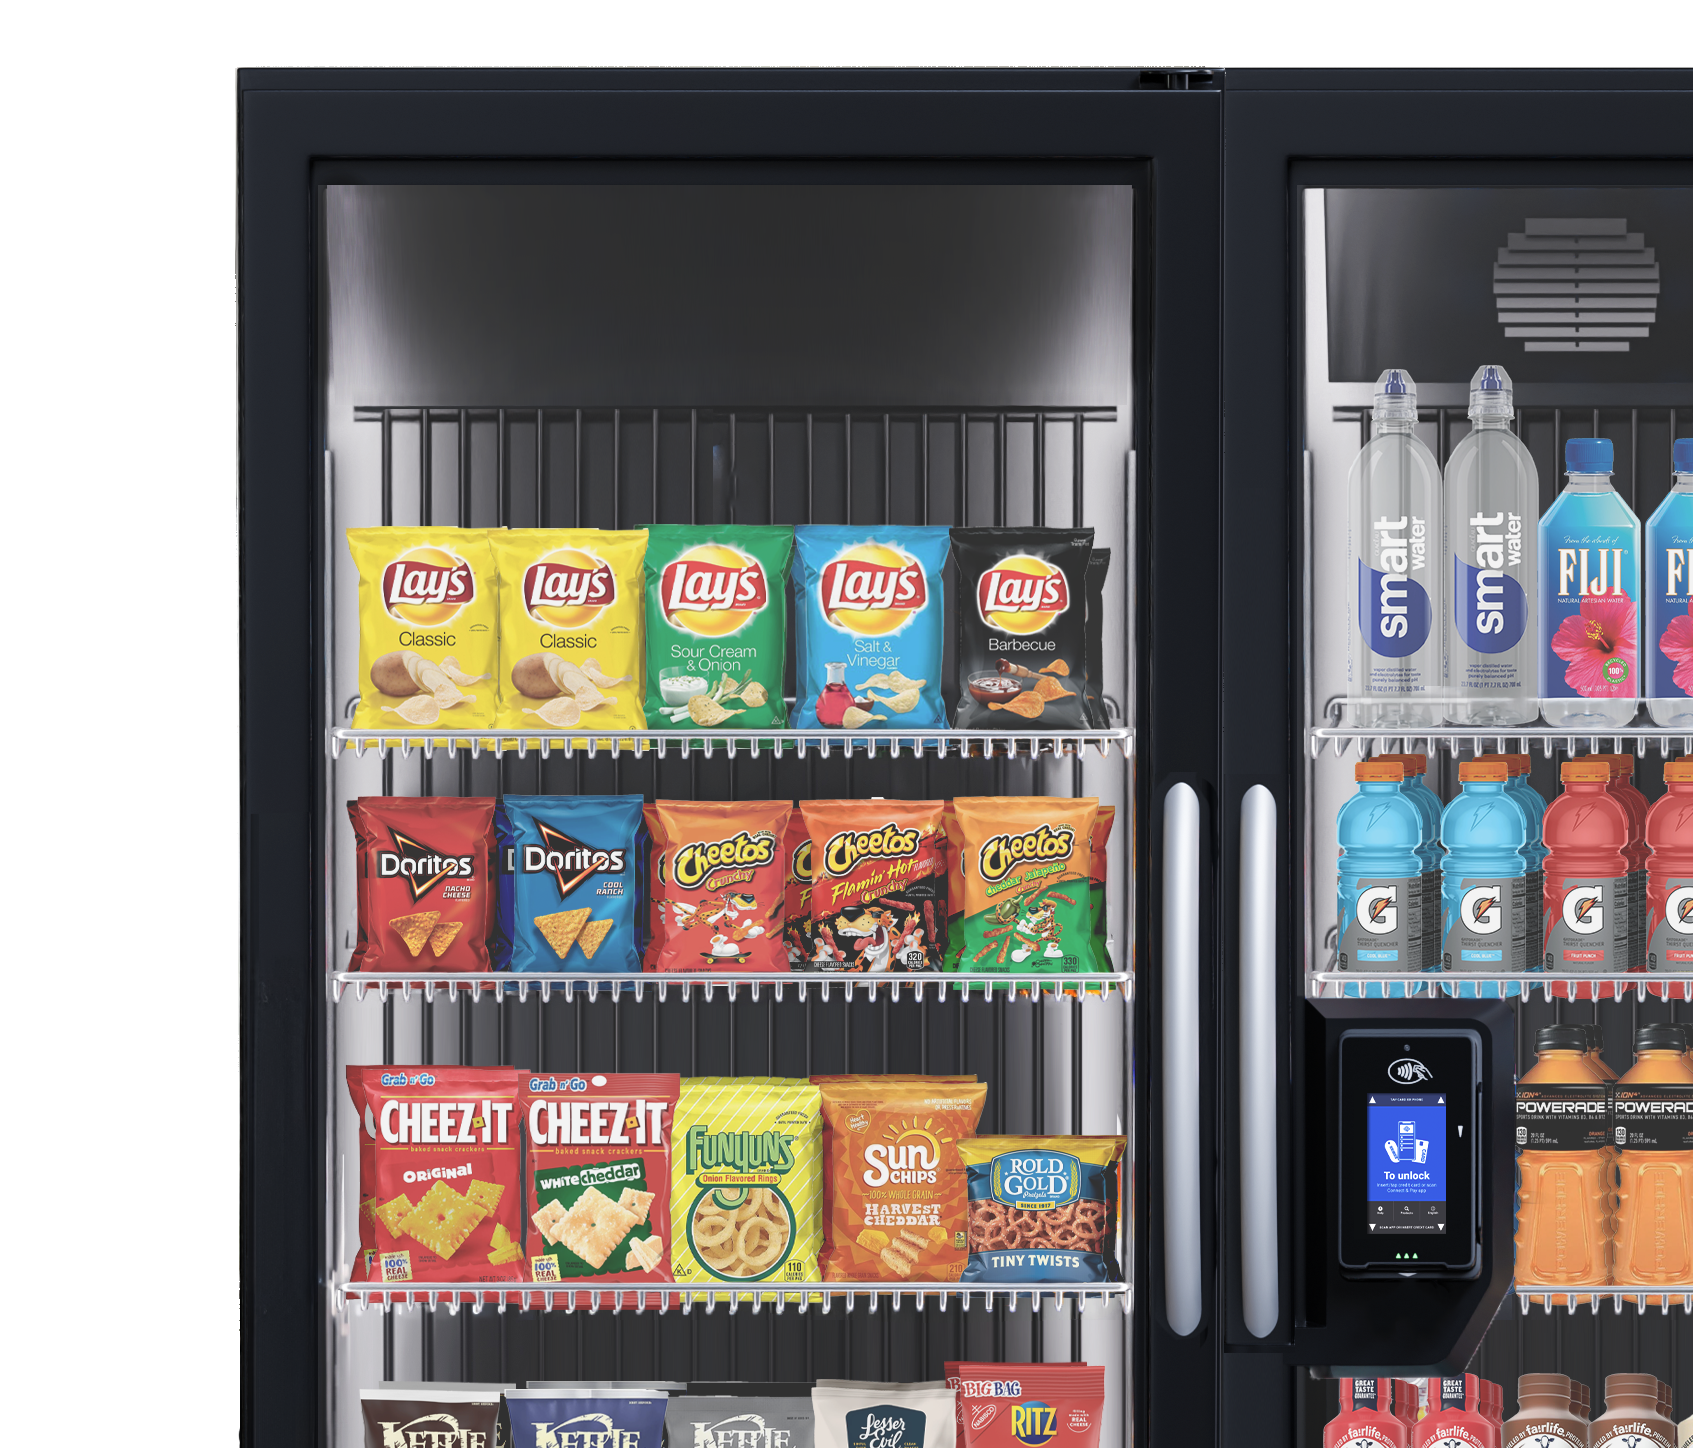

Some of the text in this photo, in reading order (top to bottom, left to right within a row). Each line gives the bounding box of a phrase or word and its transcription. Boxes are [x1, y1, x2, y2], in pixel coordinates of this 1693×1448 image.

[1411, 516, 1426, 571] water
[1506, 511, 1522, 567] water
[389, 563, 467, 605] Lay's
[1374, 515, 1408, 639] smart
[1470, 511, 1504, 635] smart
[1558, 548, 1623, 596] FIJI
[530, 565, 608, 607] Lay's
[668, 563, 759, 611] Lay's
[828, 563, 918, 610] Lay's
[984, 572, 1062, 613] Lay's
[399, 631, 456, 647] Classic
[540, 633, 597, 649] Classic
[989, 638, 1056, 651] Barbecue
[671, 645, 757, 658] Sour Cream
[686, 659, 741, 671] & Onion
[524, 847, 624, 871] Doritos
[676, 832, 774, 885] Cheetos
[827, 826, 918, 873] Cheetos
[982, 827, 1073, 878] Cheetos
[381, 853, 472, 876] Doritos
[887, 859, 918, 881] Hot
[1356, 885, 1398, 935] G
[1460, 885, 1502, 935] G
[1563, 885, 1605, 935] G
[1516, 1101, 1606, 1113] POWERADE
[703, 1174, 778, 1184] Onion Flavored Rings
[890, 1171, 937, 1184] CHIPS
[1010, 1159, 1063, 1175] ROLD
[1384, 1171, 1430, 1180] To unlock
[869, 1191, 934, 1199] 100% WHOLE GRAIN
[1004, 1175, 1067, 1195] GOLD
[864, 1215, 940, 1226] CHEDDAR
[865, 1204, 941, 1215] HARVEST
[992, 1255, 1080, 1268] TINY TWISTS
[1011, 1405, 1058, 1437] RITZ
